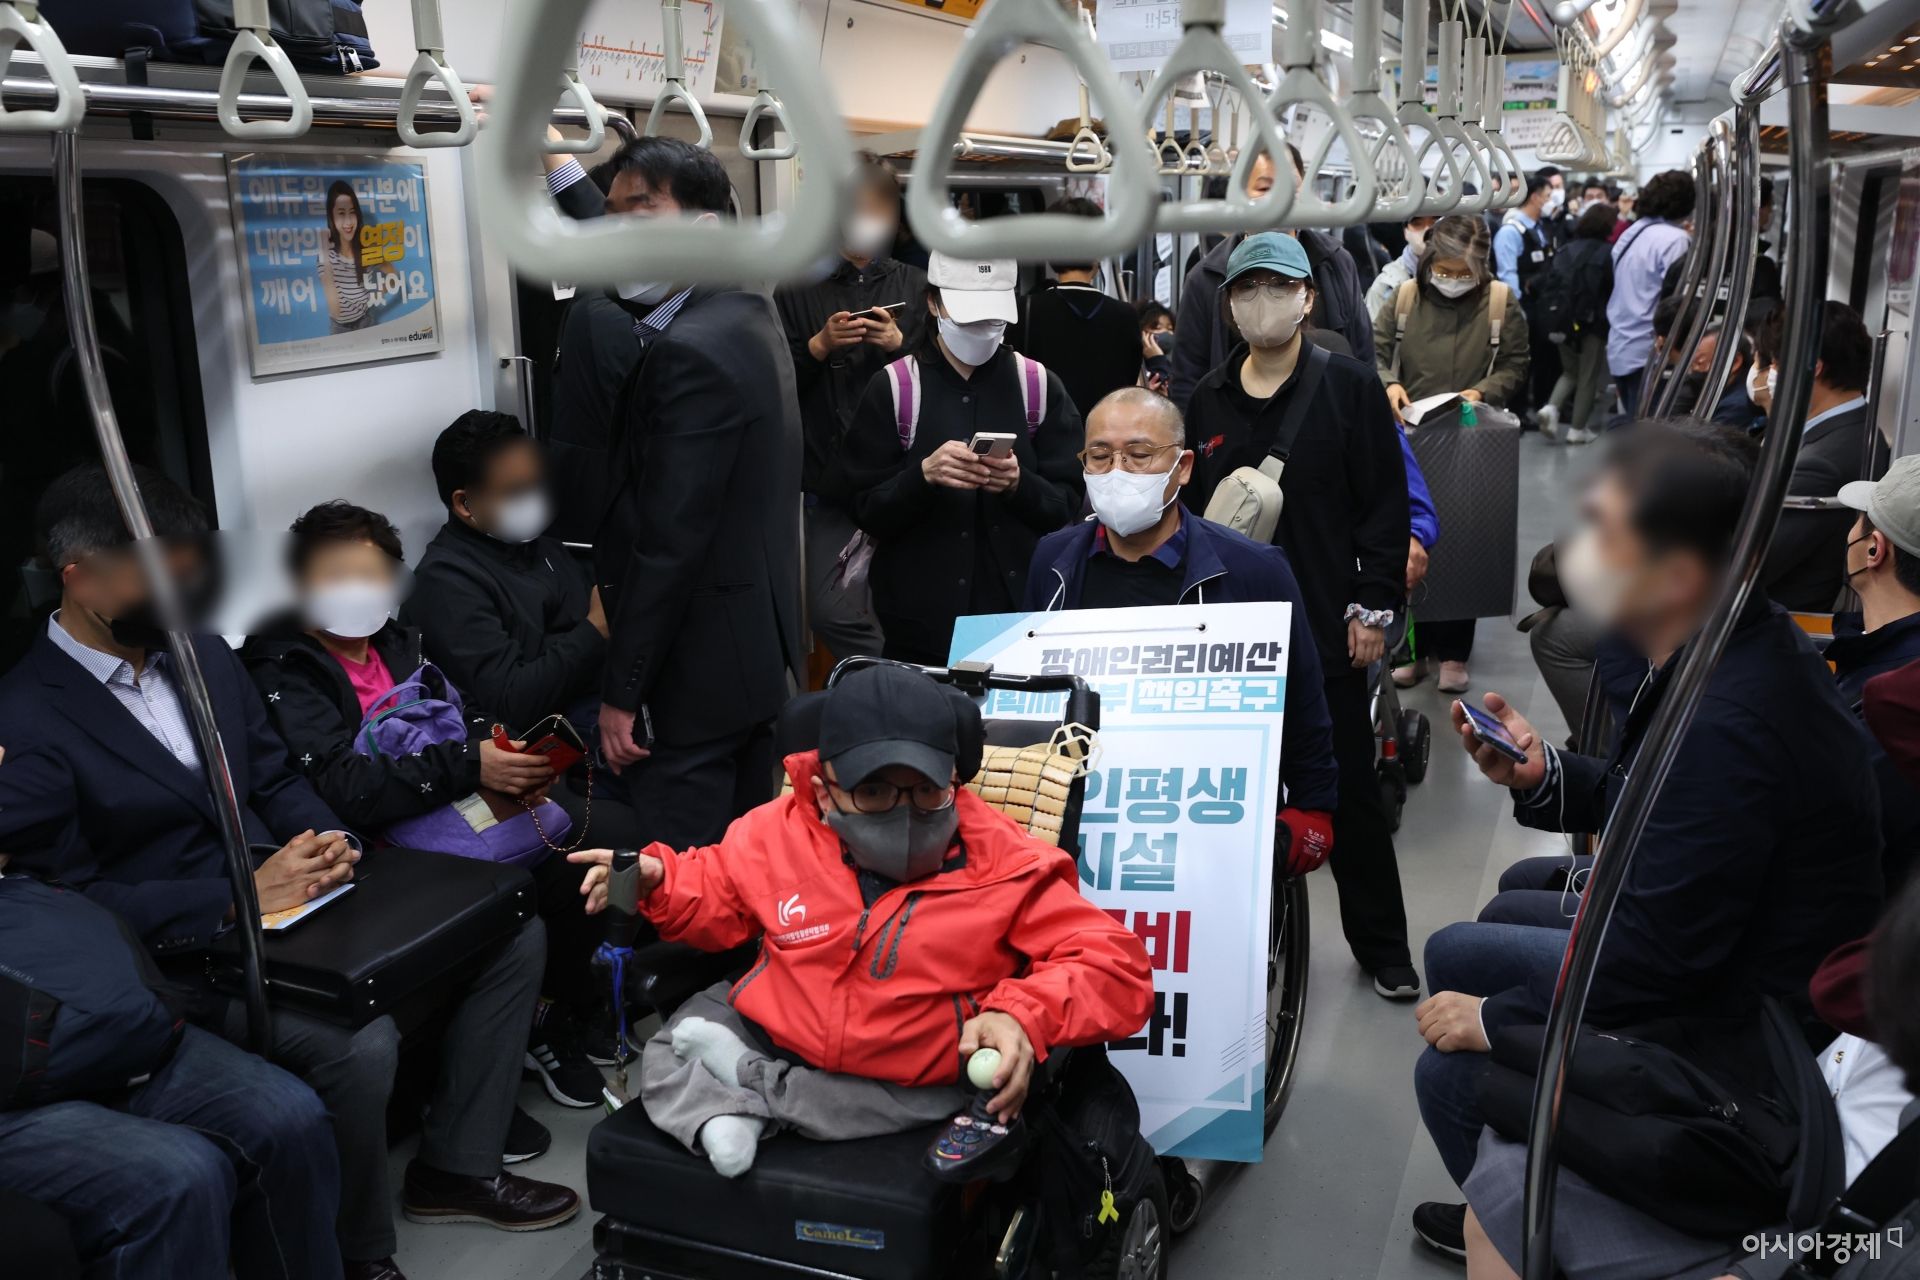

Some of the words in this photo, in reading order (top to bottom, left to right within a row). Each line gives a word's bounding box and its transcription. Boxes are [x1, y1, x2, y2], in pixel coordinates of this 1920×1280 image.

[249, 177, 327, 216] 에듀윌
[351, 177, 420, 213] 덕분에
[254, 226, 325, 266] 내안의
[360, 220, 424, 268] 열정이
[260, 276, 317, 315] 깨어
[362, 270, 428, 308] 났어요
[408, 330, 433, 342] eduwill
[1040, 641, 1282, 676] 장애인권리예산
[1137, 678, 1278, 711] 책임촉구
[1102, 908, 1192, 973] 비
